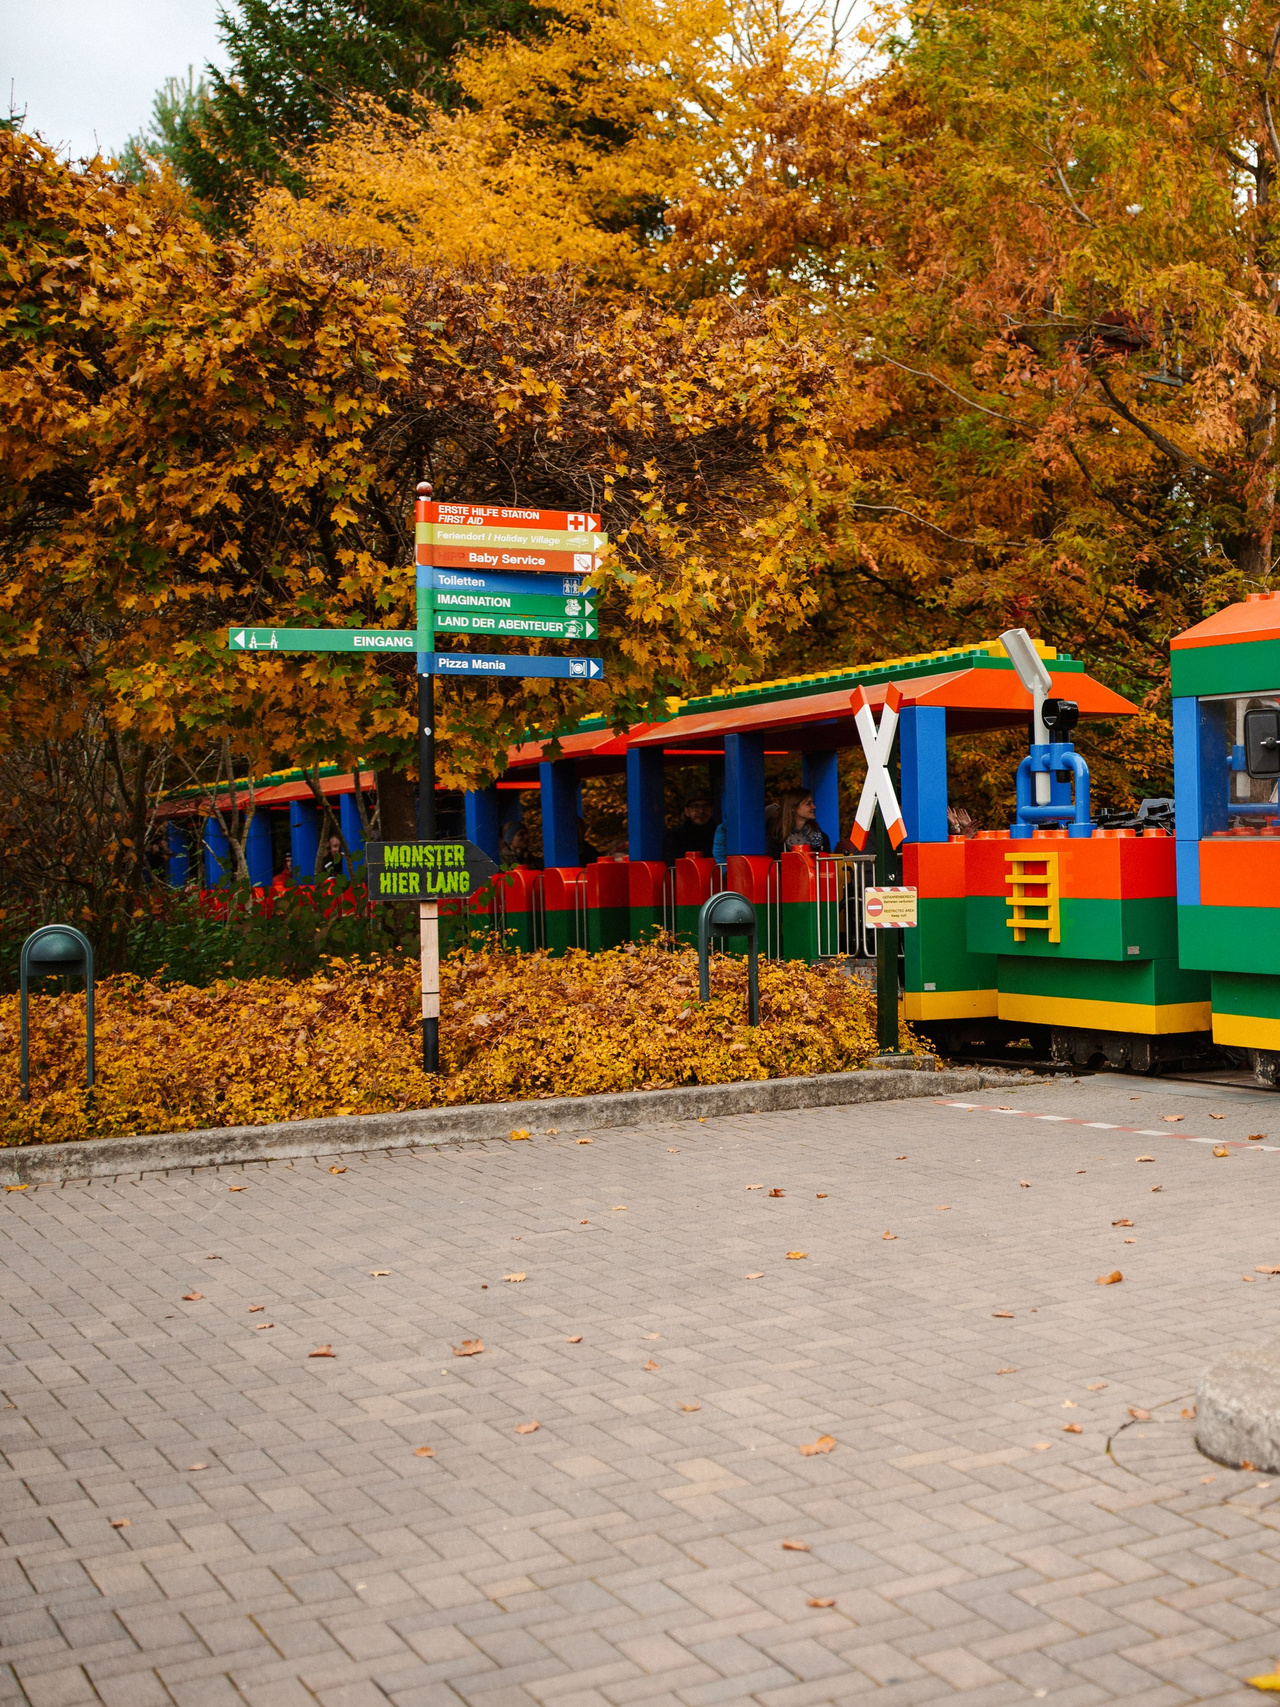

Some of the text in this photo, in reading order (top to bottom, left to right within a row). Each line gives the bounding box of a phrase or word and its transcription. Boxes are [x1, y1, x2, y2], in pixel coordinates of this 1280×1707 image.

[438, 505, 540, 520] ERSTE HILFE STATION
[438, 514, 484, 526] FIRST AID
[437, 530, 560, 546] Feriendorf / Holiday Village
[469, 552, 499, 566] Baby
[501, 554, 546, 566] Service
[438, 575, 485, 588] Toiletten
[437, 594, 511, 608] IMAGINATION
[437, 615, 564, 632] LAND DER ABENTEUER
[353, 636, 413, 647] EINGANG
[438, 658, 506, 670] Pizza Mania
[384, 844, 465, 870] MONSTER
[380, 871, 470, 895] HIER LANG
